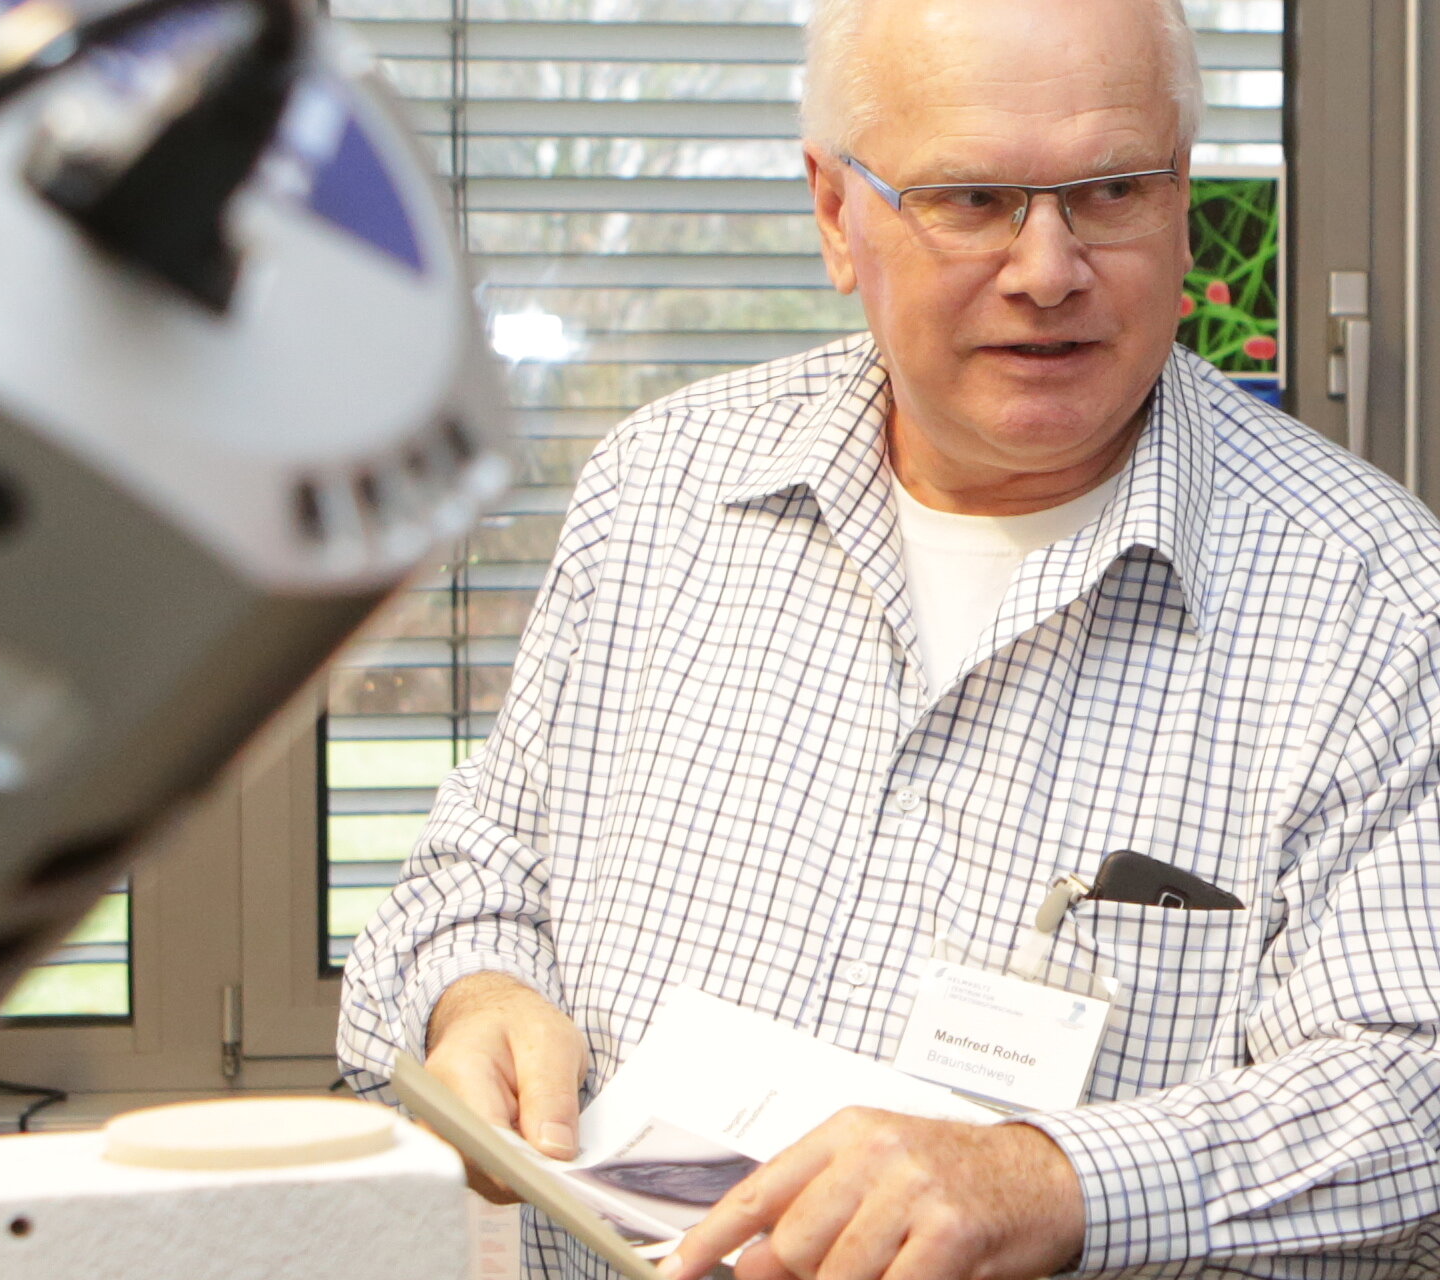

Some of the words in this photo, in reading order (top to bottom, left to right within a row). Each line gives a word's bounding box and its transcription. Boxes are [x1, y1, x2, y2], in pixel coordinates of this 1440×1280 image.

[934, 1028, 990, 1054] Manfred
[993, 1045, 1036, 1066] Rohde
[927, 1049, 1016, 1087] Braunschweig
